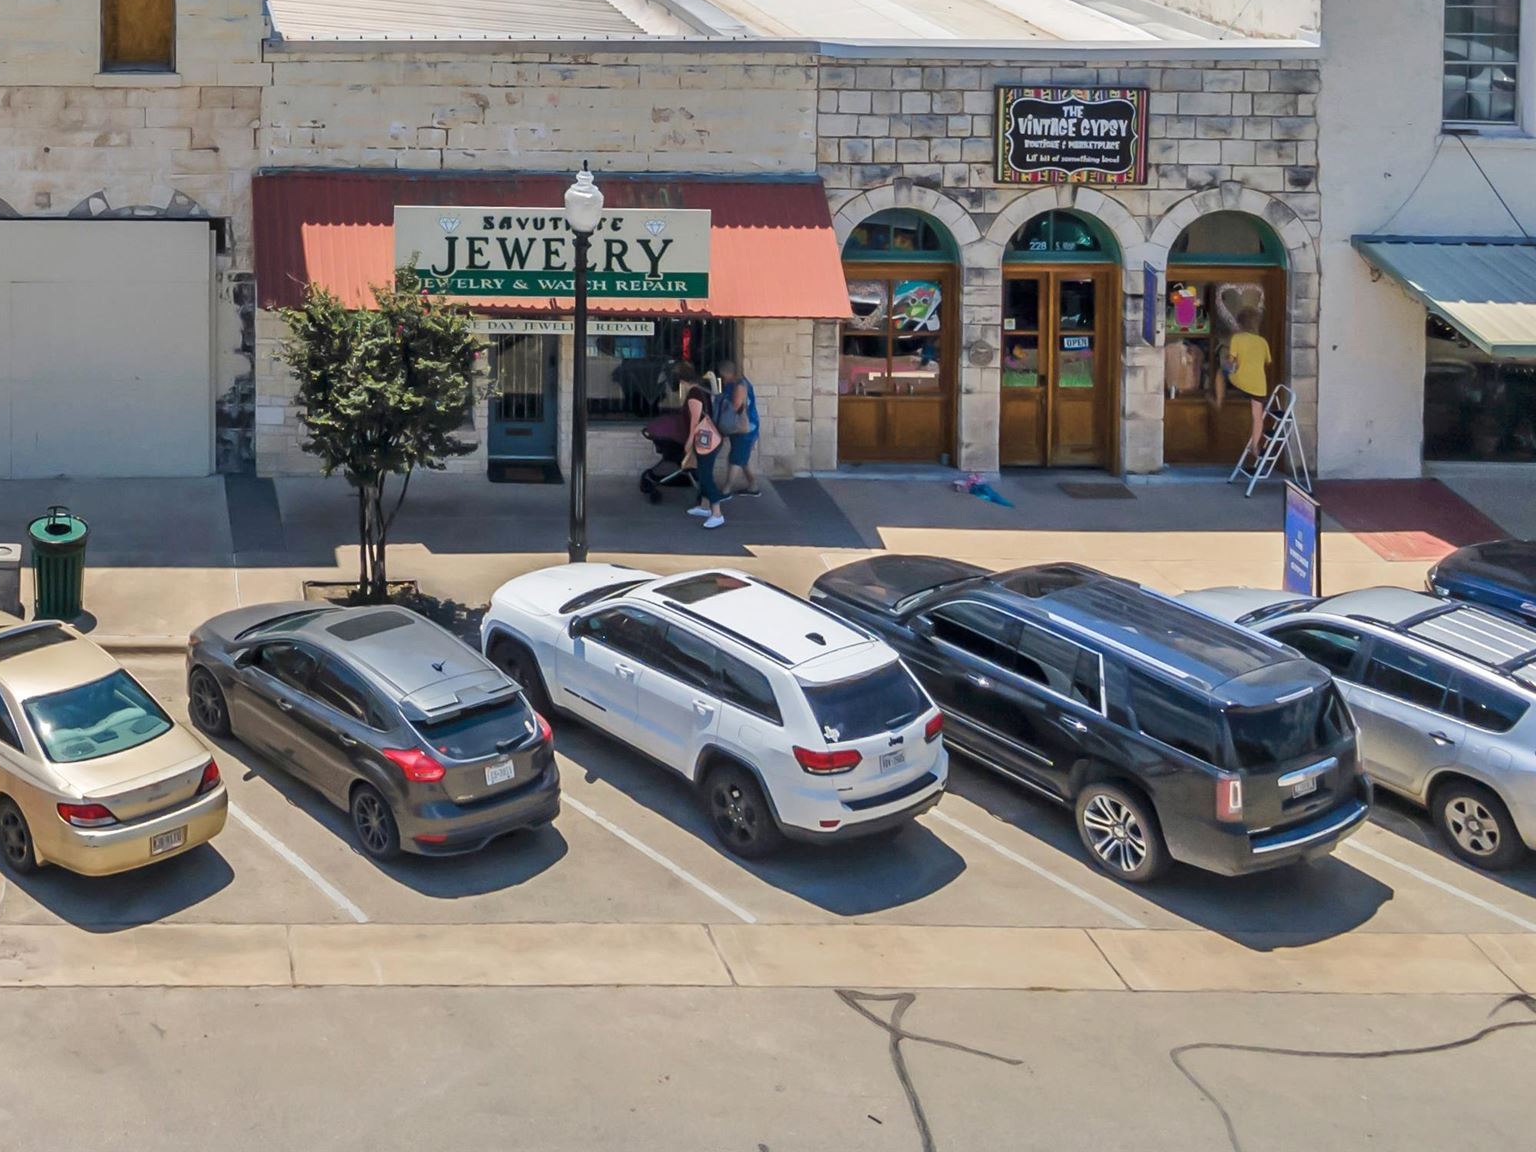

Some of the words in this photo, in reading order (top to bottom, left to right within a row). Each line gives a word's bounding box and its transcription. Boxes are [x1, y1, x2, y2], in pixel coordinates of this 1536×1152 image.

[1062, 105, 1084, 118] THE
[1080, 118, 1128, 137] GYPSY
[1029, 241, 1047, 250] 228
[512, 279, 529, 289] &
[616, 281, 688, 291] REPAIR
[488, 321, 514, 330] DAY
[596, 323, 650, 332] REPAIR
[1066, 338, 1087, 347] OPEN
